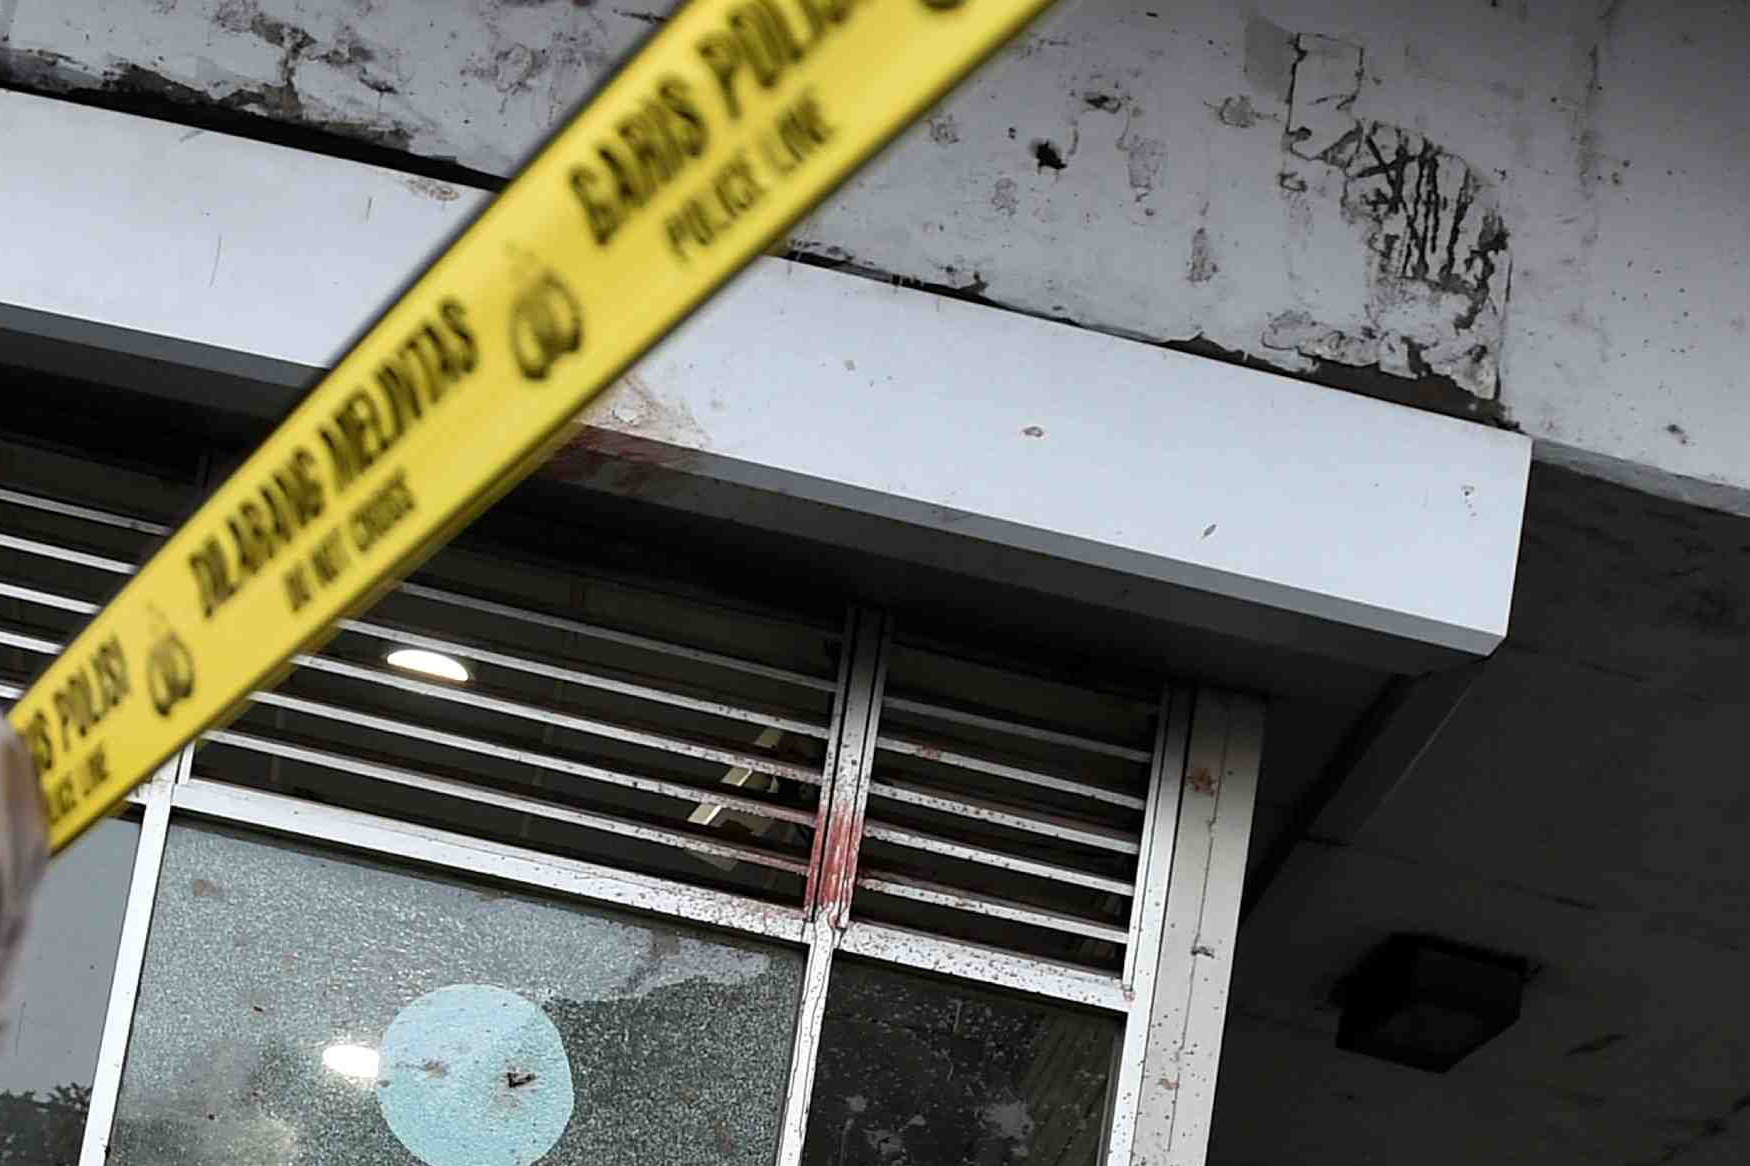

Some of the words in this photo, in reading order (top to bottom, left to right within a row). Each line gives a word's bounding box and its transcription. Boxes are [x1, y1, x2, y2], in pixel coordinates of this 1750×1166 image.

[665, 150, 765, 261] POLICE
[188, 446, 326, 619] DILARANG
[317, 298, 480, 493] MELINTAS
